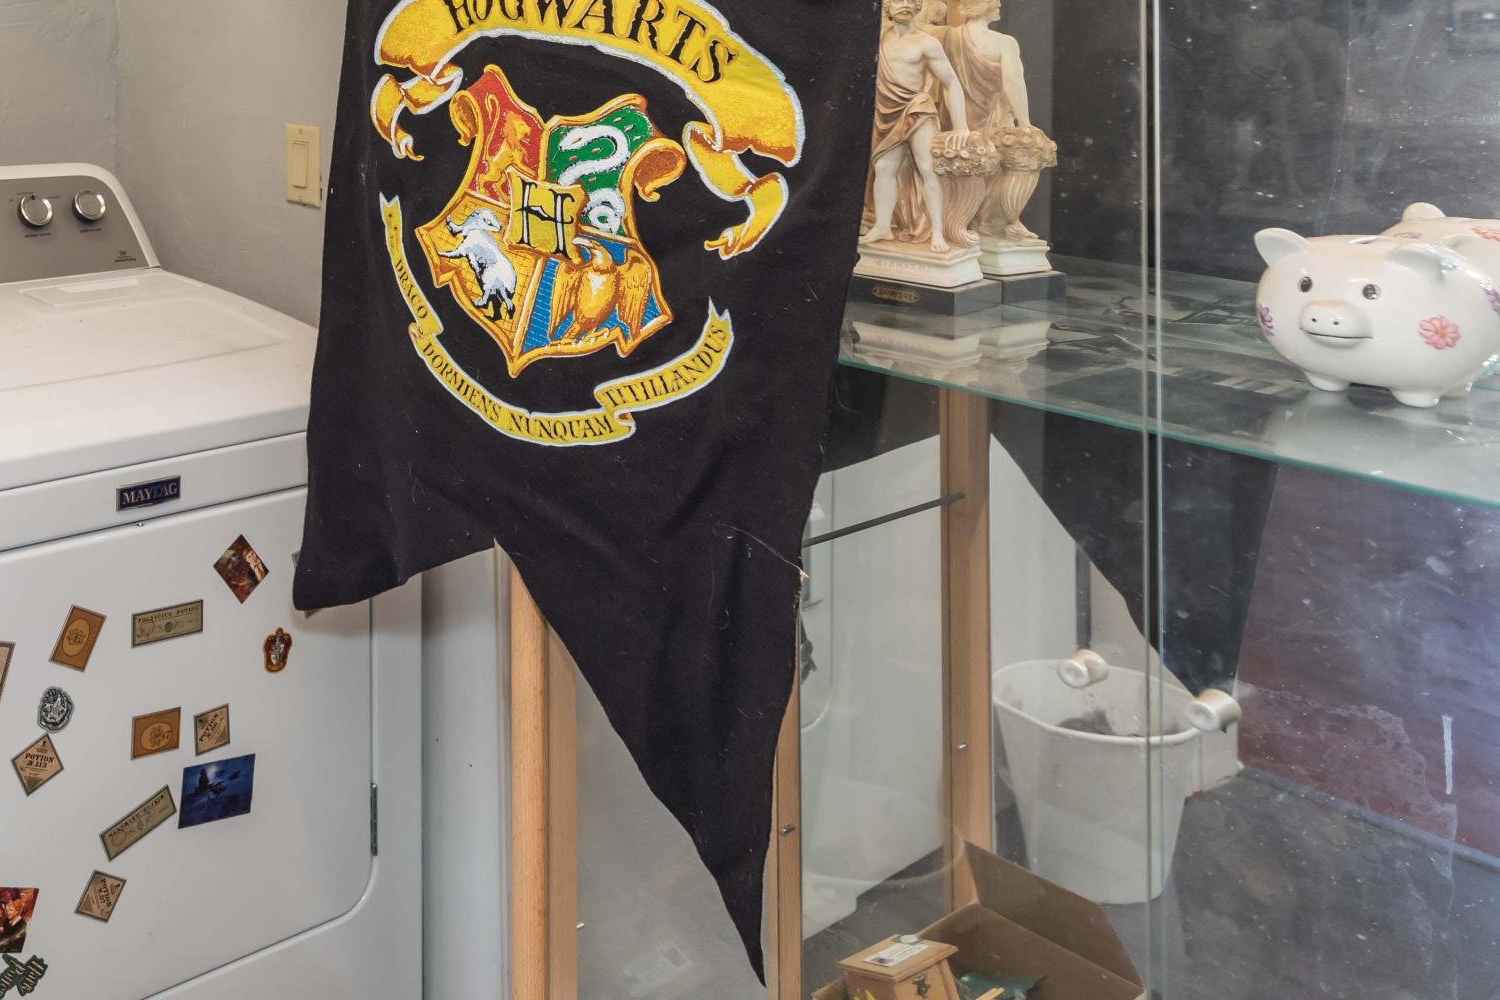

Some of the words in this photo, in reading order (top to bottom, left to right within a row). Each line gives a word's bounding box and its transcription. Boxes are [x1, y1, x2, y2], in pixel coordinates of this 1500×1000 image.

[395, 259, 428, 319] DRACO
[422, 343, 502, 423] DORMIENS
[508, 412, 616, 442] NUNQUAM
[602, 325, 728, 408] TITILLANDUS
[122, 482, 178, 505] MAYTAG
[25, 753, 54, 763] POTION
